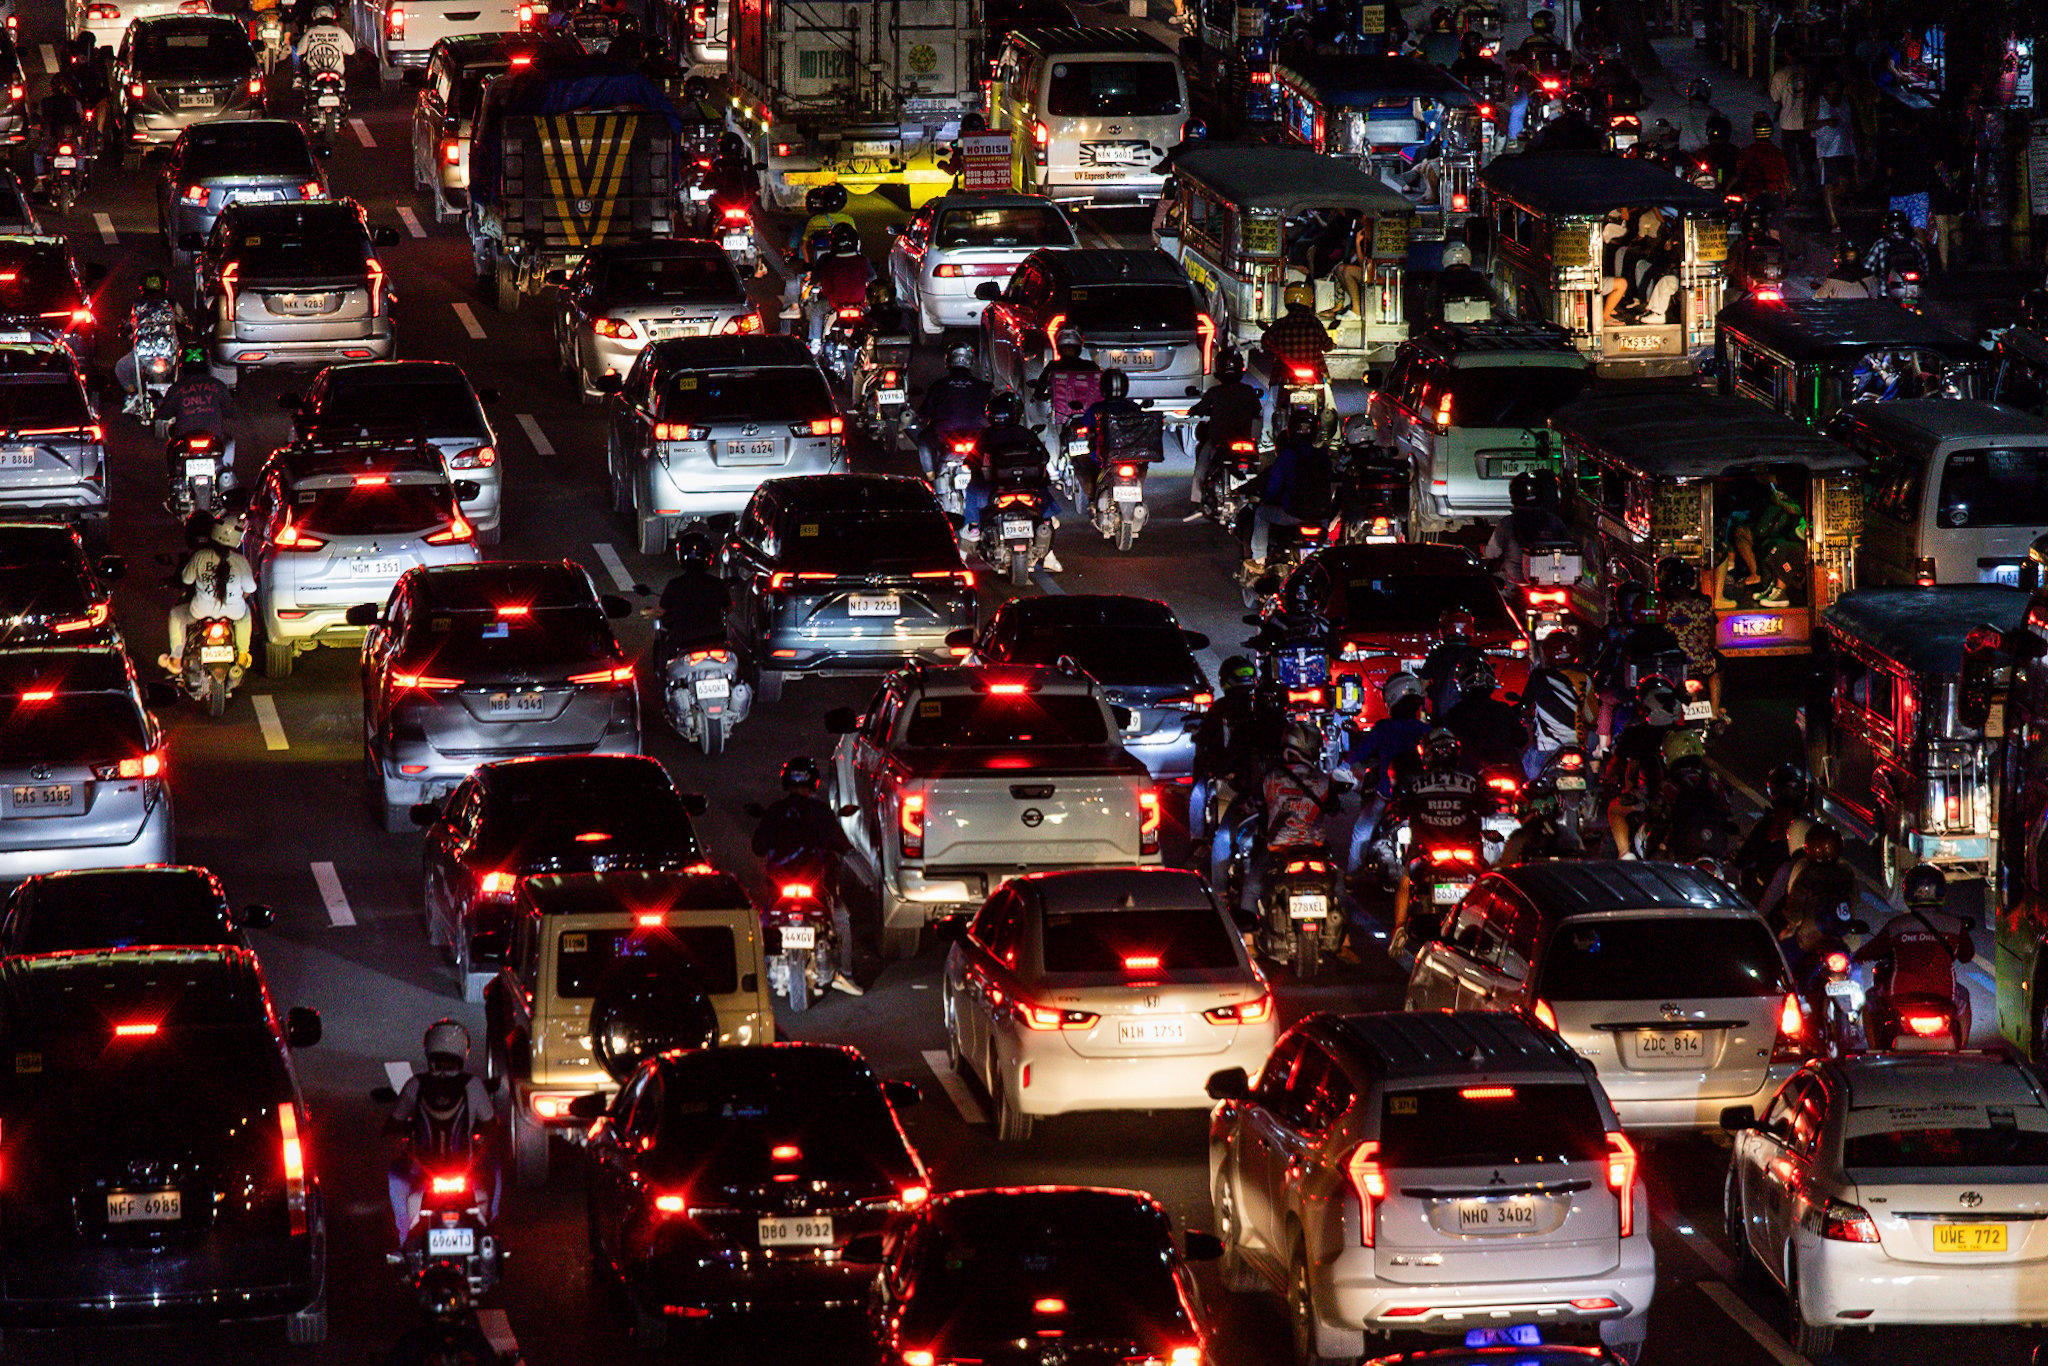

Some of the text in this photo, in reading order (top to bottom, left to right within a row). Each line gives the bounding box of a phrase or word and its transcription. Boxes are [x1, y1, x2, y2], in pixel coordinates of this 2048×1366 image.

[967, 145, 1008, 154] HOTDISH
[1074, 170, 1126, 182] UV Express Service
[183, 396, 213, 407] ONLY
[730, 444, 772, 454] DAS 6124
[12, 455, 33, 464] 8888
[353, 562, 400, 574] NGM 1351
[851, 601, 898, 612] NIJ 2251
[517, 699, 543, 710] 4141
[15, 789, 71, 804] CAS 5185
[1427, 800, 1462, 810] RIDE
[1293, 902, 1325, 913] 278XEL
[1902, 933, 1917, 943] ONE
[1121, 1025, 1184, 1040] NIH 1751
[1643, 1036, 1697, 1051] ZDC 814
[109, 1200, 180, 1217] NFF 6985
[1498, 1207, 1532, 1222] 3402
[796, 1223, 830, 1237] 9812
[1941, 1229, 2000, 1244] UWE 772
[433, 1236, 471, 1250] 696WTJ
